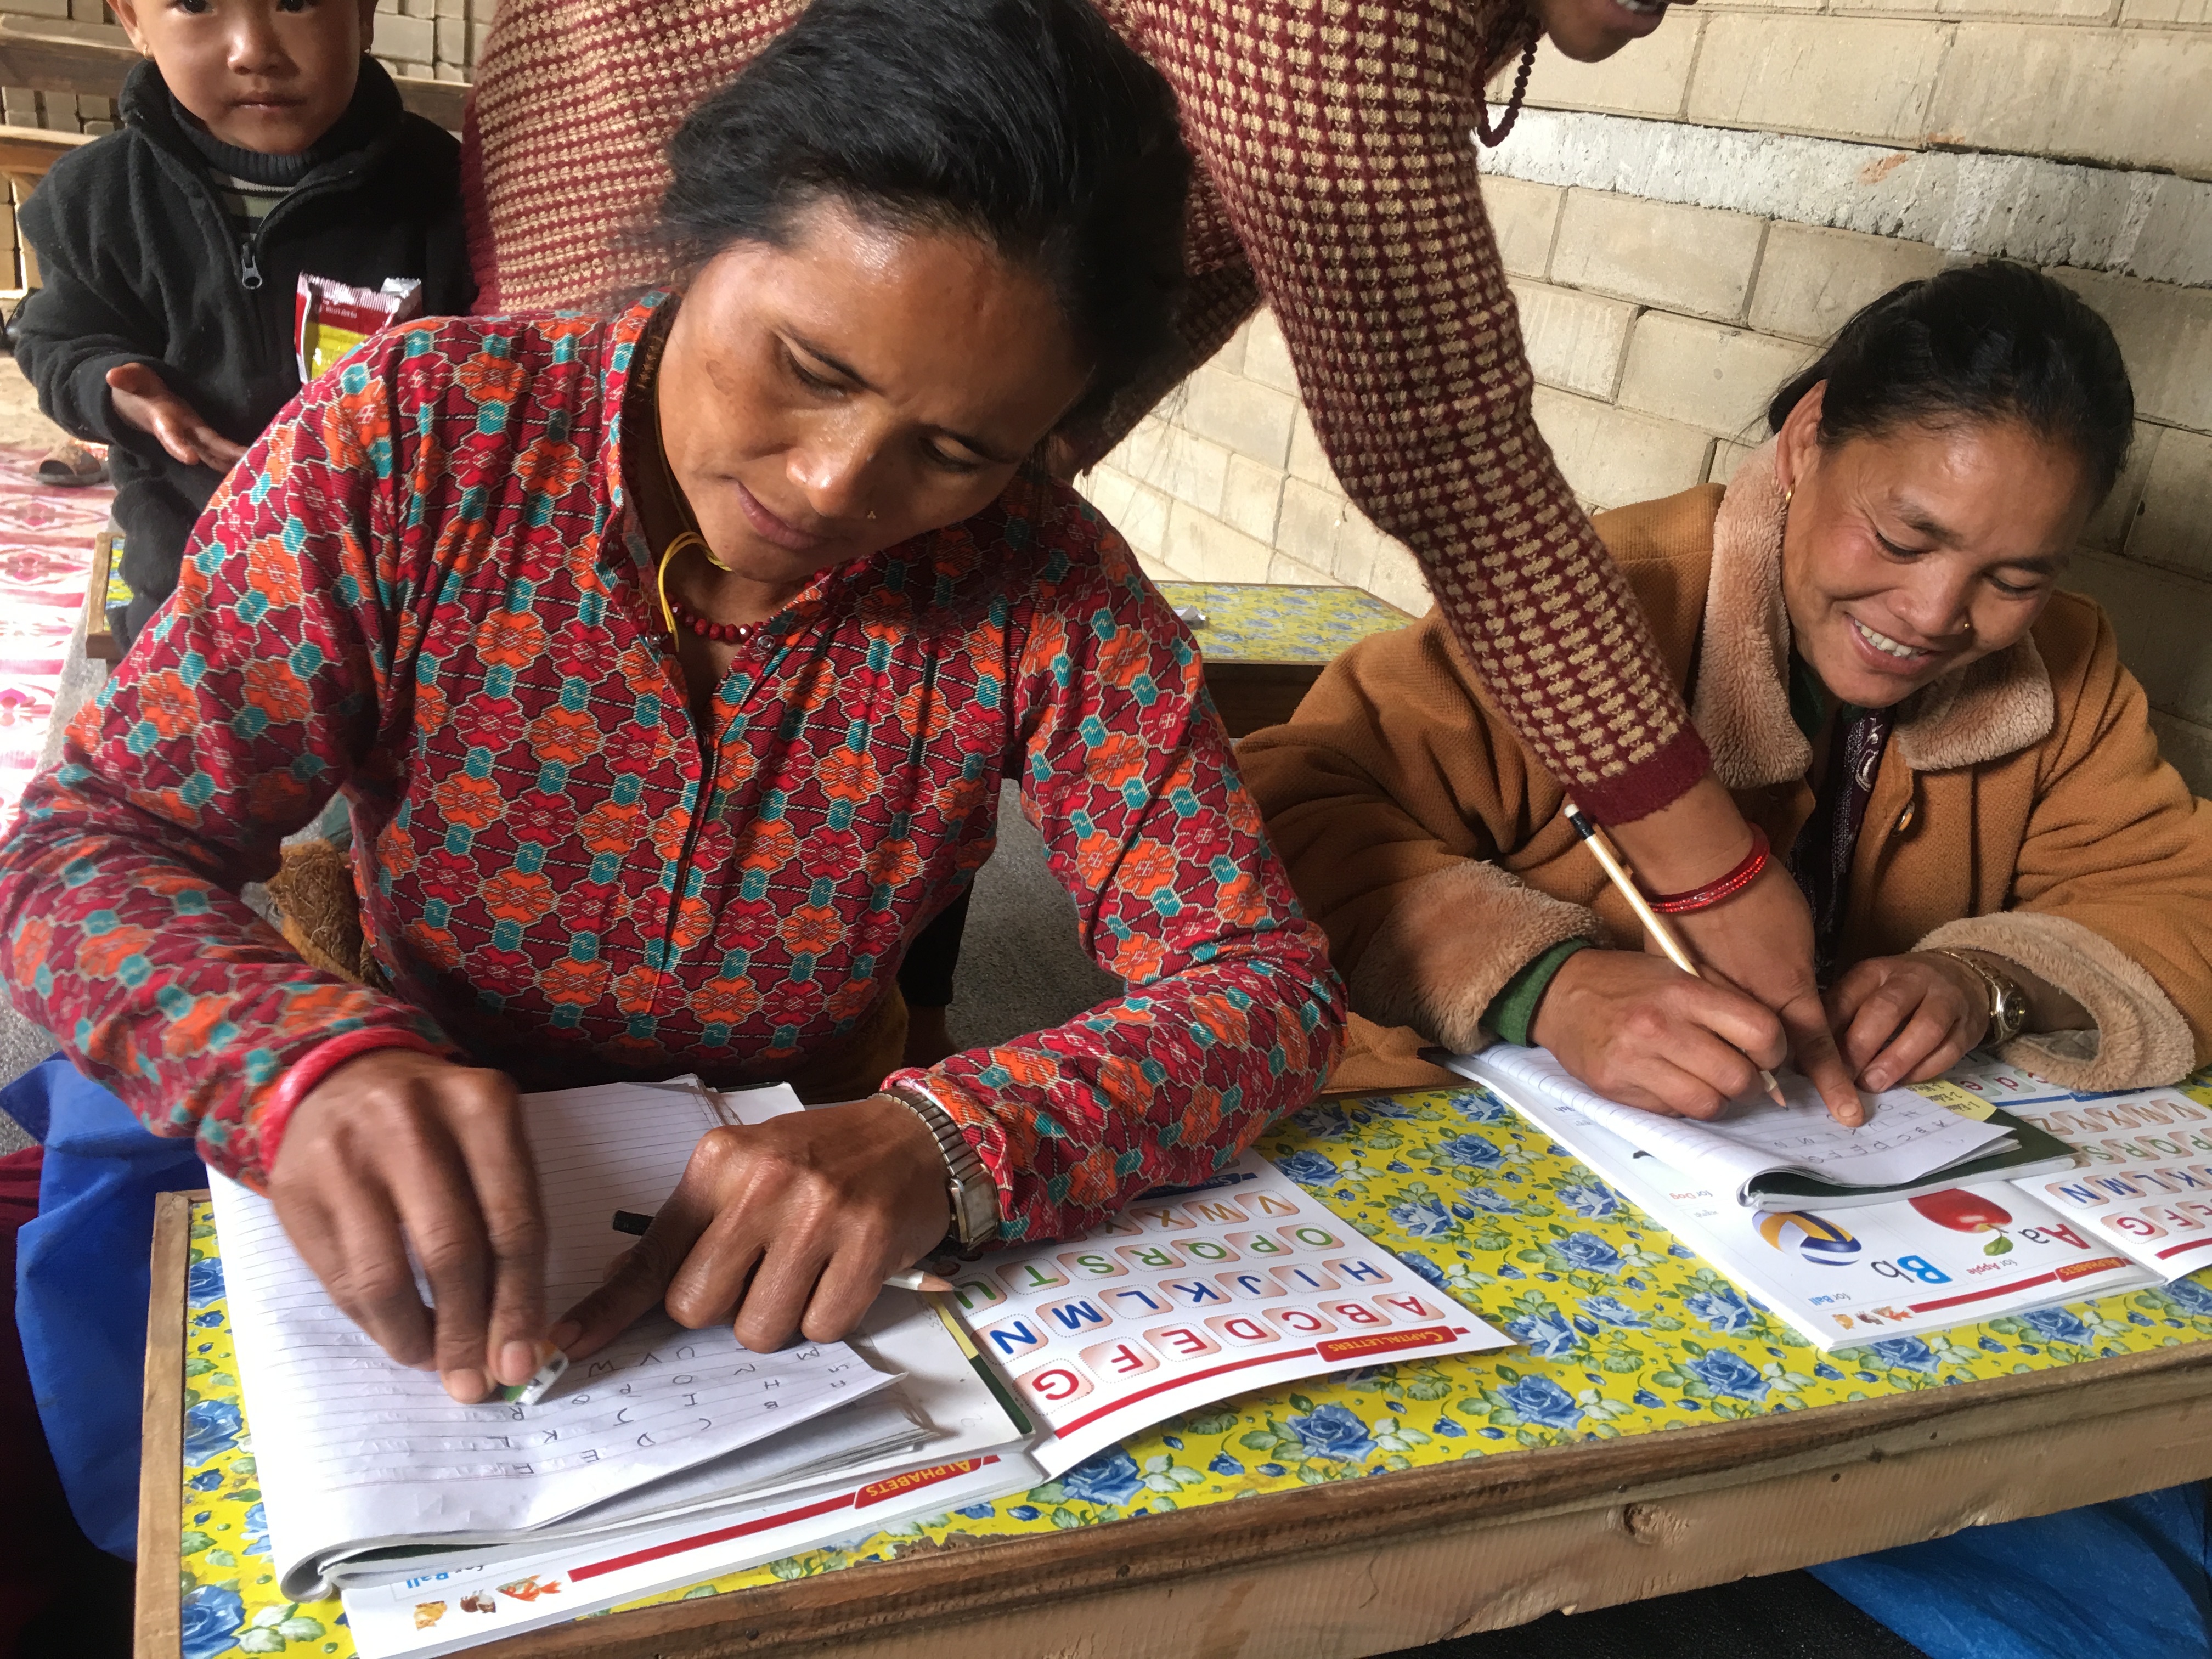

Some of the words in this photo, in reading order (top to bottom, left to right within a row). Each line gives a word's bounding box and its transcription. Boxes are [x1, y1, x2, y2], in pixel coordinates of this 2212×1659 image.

[1960, 1081, 1983, 1090] e
[1994, 1077, 2019, 1091] d
[2095, 1110, 2129, 1125] X
[2130, 1107, 2168, 1122] W
[2168, 1103, 2199, 1118] V
[2027, 1118, 2064, 1132] Z
[2067, 1115, 2098, 1130] Y
[2081, 1146, 2114, 1160] S
[2111, 1142, 2150, 1157] R
[2143, 1139, 2182, 1154] Q
[2095, 1178, 2138, 1195] M
[2132, 1175, 2170, 1189] L
[2165, 1171, 2206, 1187] K
[1669, 1192, 1696, 1200] Dog
[2059, 1184, 2101, 1203] N
[1198, 1203, 1242, 1222] W
[1258, 1195, 1291, 1214] V
[1145, 1209, 1185, 1227] X
[2117, 1217, 2155, 1235] G
[2164, 1209, 2193, 1227] F
[1250, 1234, 1280, 1253] P
[1296, 1228, 1333, 1246] O
[2018, 1223, 2091, 1249] Aa
[1129, 1247, 1173, 1266] R
[1180, 1242, 1227, 1259] Q
[1076, 1255, 1114, 1274] S
[1339, 1261, 1384, 1282] H
[1871, 1255, 1953, 1284] Bb
[1966, 1263, 2000, 1275] Apple
[2002, 1259, 2018, 1267] for
[2060, 1258, 2122, 1276] ALPHABETS
[1024, 1265, 1059, 1287] T
[1294, 1269, 1320, 1287] I
[1172, 1282, 1220, 1302] K
[1237, 1276, 1261, 1294] J
[953, 1280, 997, 1309] U
[1116, 1290, 1159, 1310] L
[1809, 1295, 1835, 1306] Ball
[1833, 1293, 1851, 1301] for
[1336, 1304, 1379, 1323] B
[1387, 1296, 1427, 1316] A
[1051, 1301, 1104, 1329] M
[1282, 1311, 1321, 1330] C
[1224, 1318, 1268, 1339] D
[990, 1321, 1037, 1354] N
[1161, 1329, 1208, 1353] E
[1328, 1338, 1384, 1352] LETTERS
[1382, 1331, 1443, 1344] CAPITAL
[639, 1352, 661, 1366] V
[676, 1346, 695, 1360] U
[1111, 1344, 1144, 1373] F
[588, 1361, 617, 1378] W
[673, 1374, 693, 1385] O
[764, 1379, 780, 1390] H
[1032, 1369, 1079, 1400] G
[685, 1393, 698, 1407] I
[764, 1401, 779, 1409] B
[509, 1407, 524, 1421] R
[613, 1408, 634, 1426] J
[699, 1418, 712, 1431] C
[487, 1436, 510, 1448] L
[543, 1430, 558, 1444] K
[637, 1433, 656, 1447] D
[582, 1449, 600, 1464] E
[514, 1463, 534, 1476] F
[865, 1460, 971, 1497] ALPHABETS
